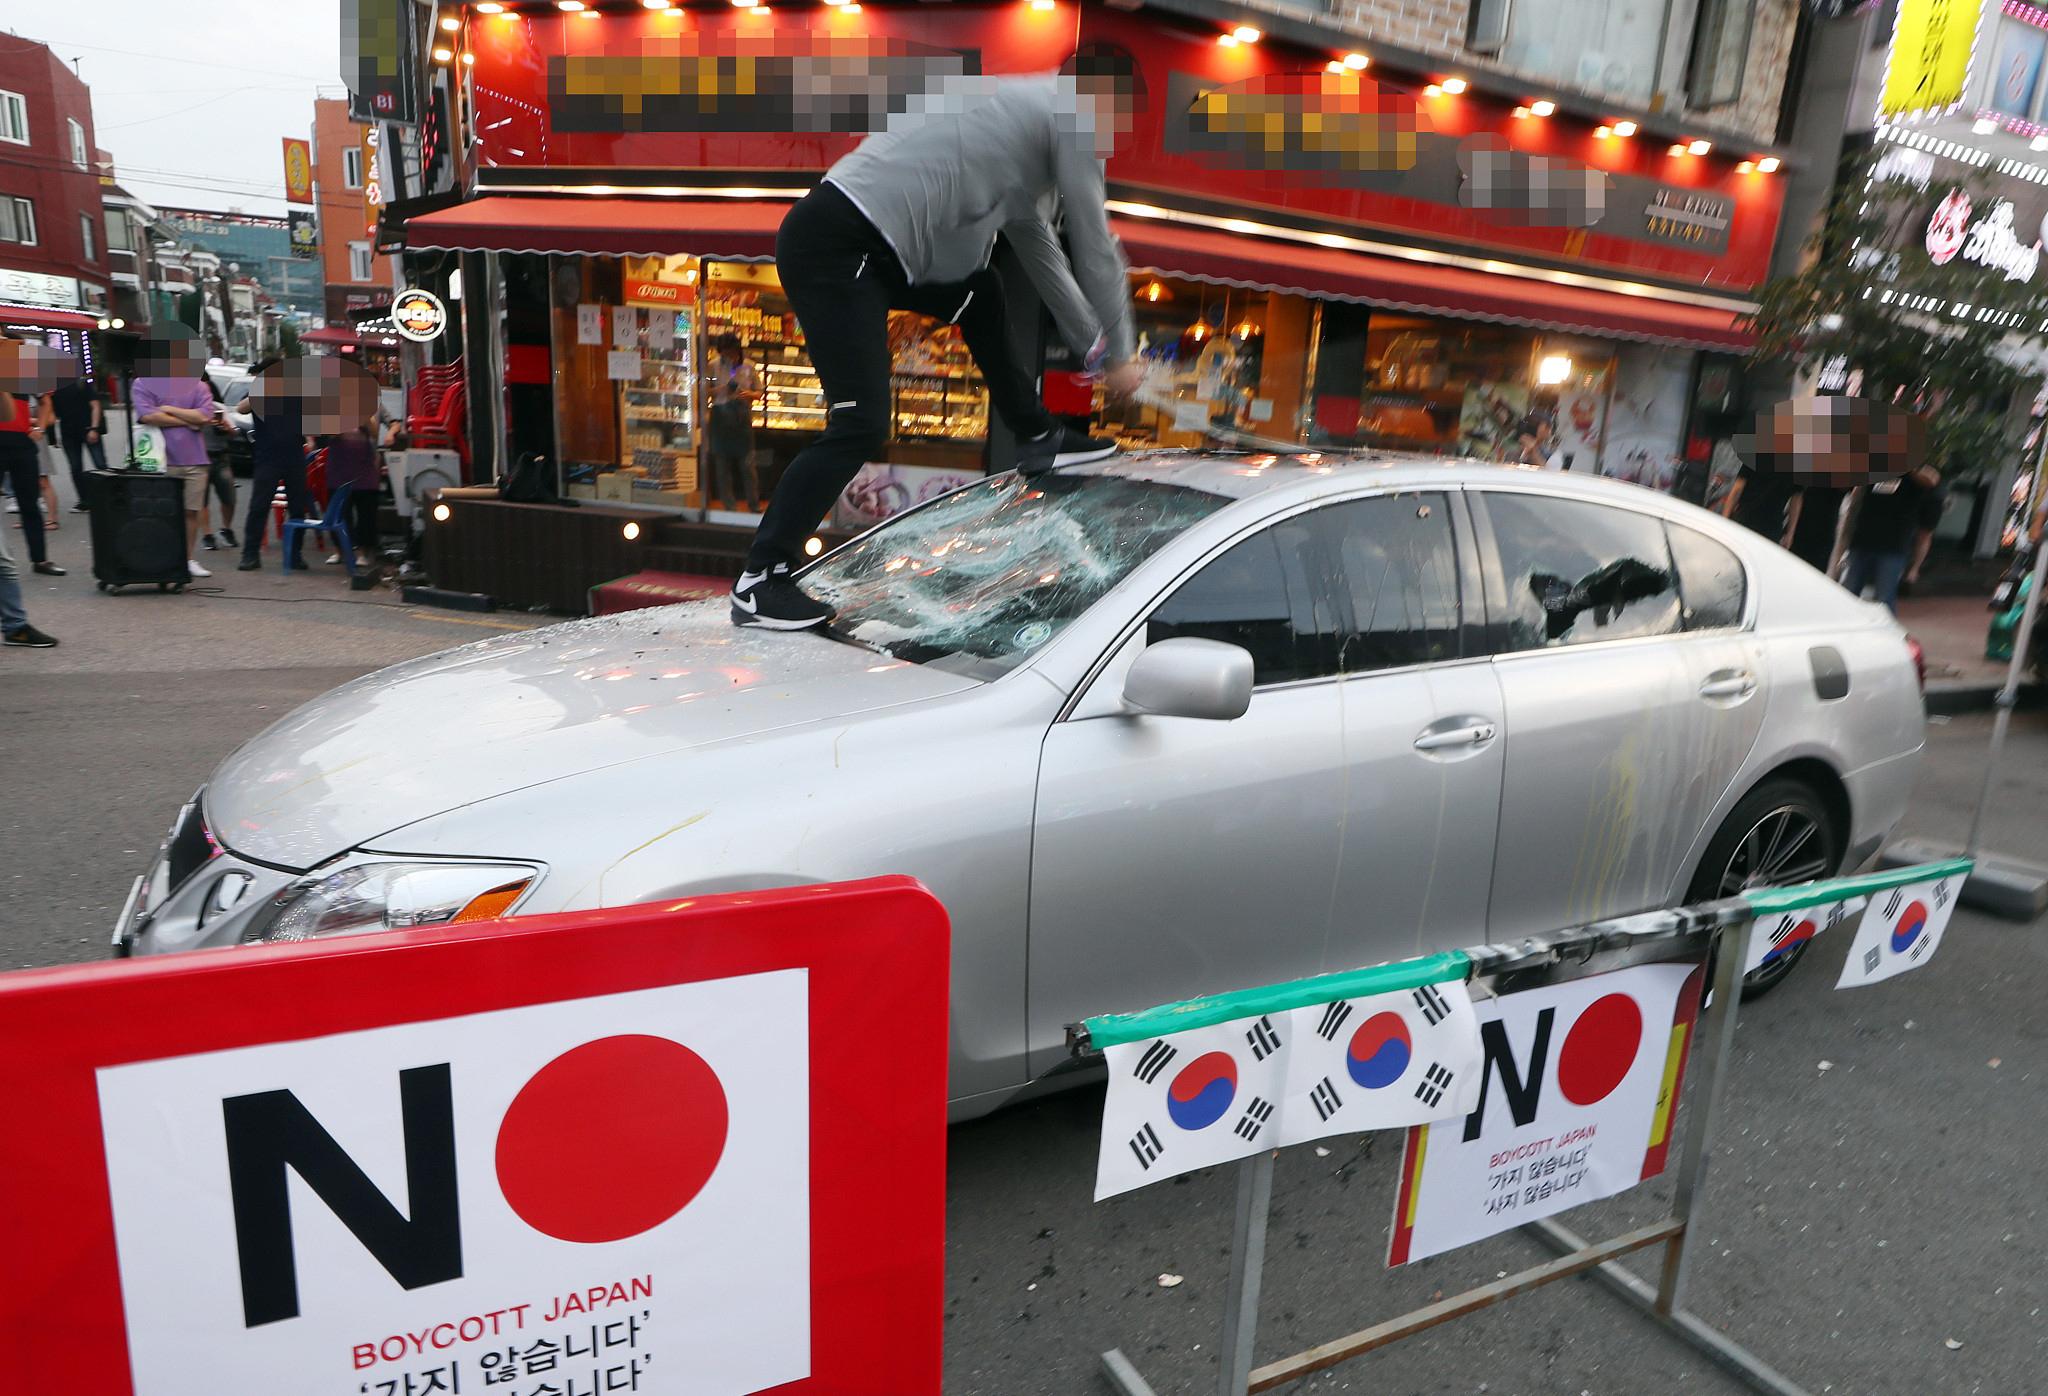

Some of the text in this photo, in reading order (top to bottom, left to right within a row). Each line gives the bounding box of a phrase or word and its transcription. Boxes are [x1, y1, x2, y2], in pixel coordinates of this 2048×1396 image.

[1489, 1123, 1598, 1168] BOYCOTT JAPAN
[352, 1274, 653, 1370] BOYCOTT JAPAN
[480, 1310, 650, 1386] 않습니다’
